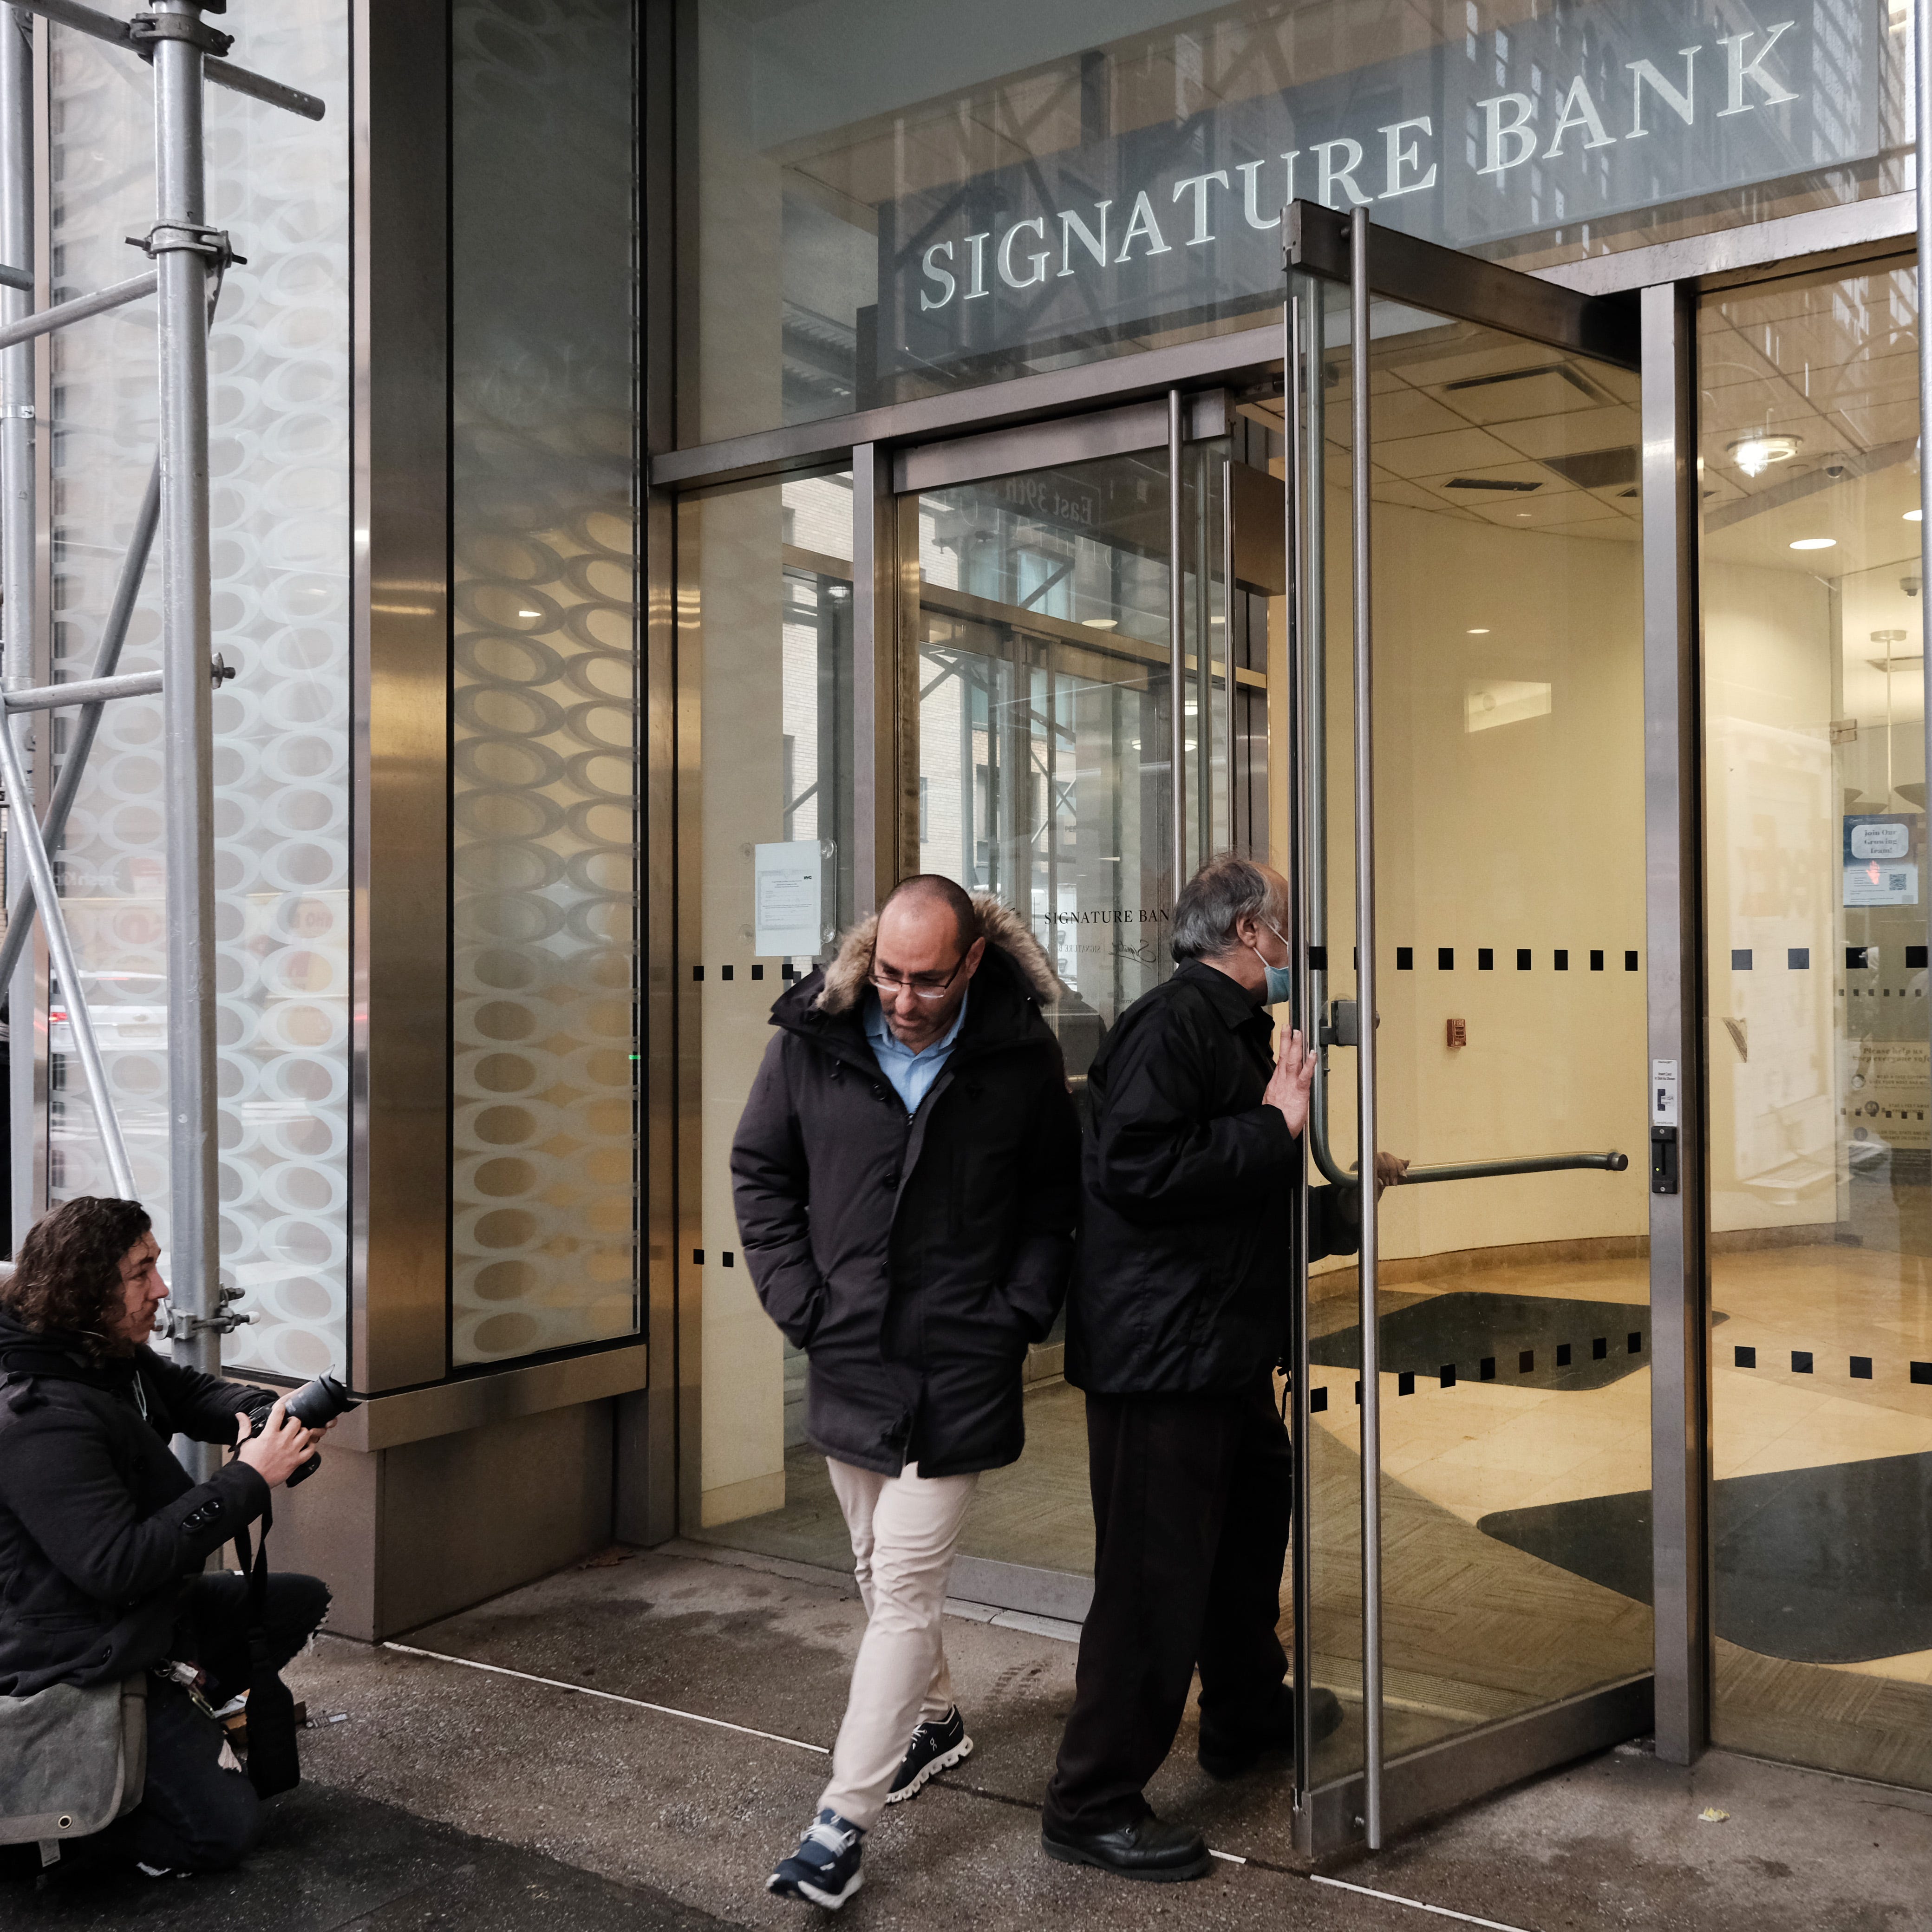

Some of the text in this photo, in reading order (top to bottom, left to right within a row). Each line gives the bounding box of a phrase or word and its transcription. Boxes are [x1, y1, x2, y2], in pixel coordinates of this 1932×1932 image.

[920, 20, 1799, 311] SIGNATURE BANK
[1044, 909, 1170, 924] SIGNATURE BAN
